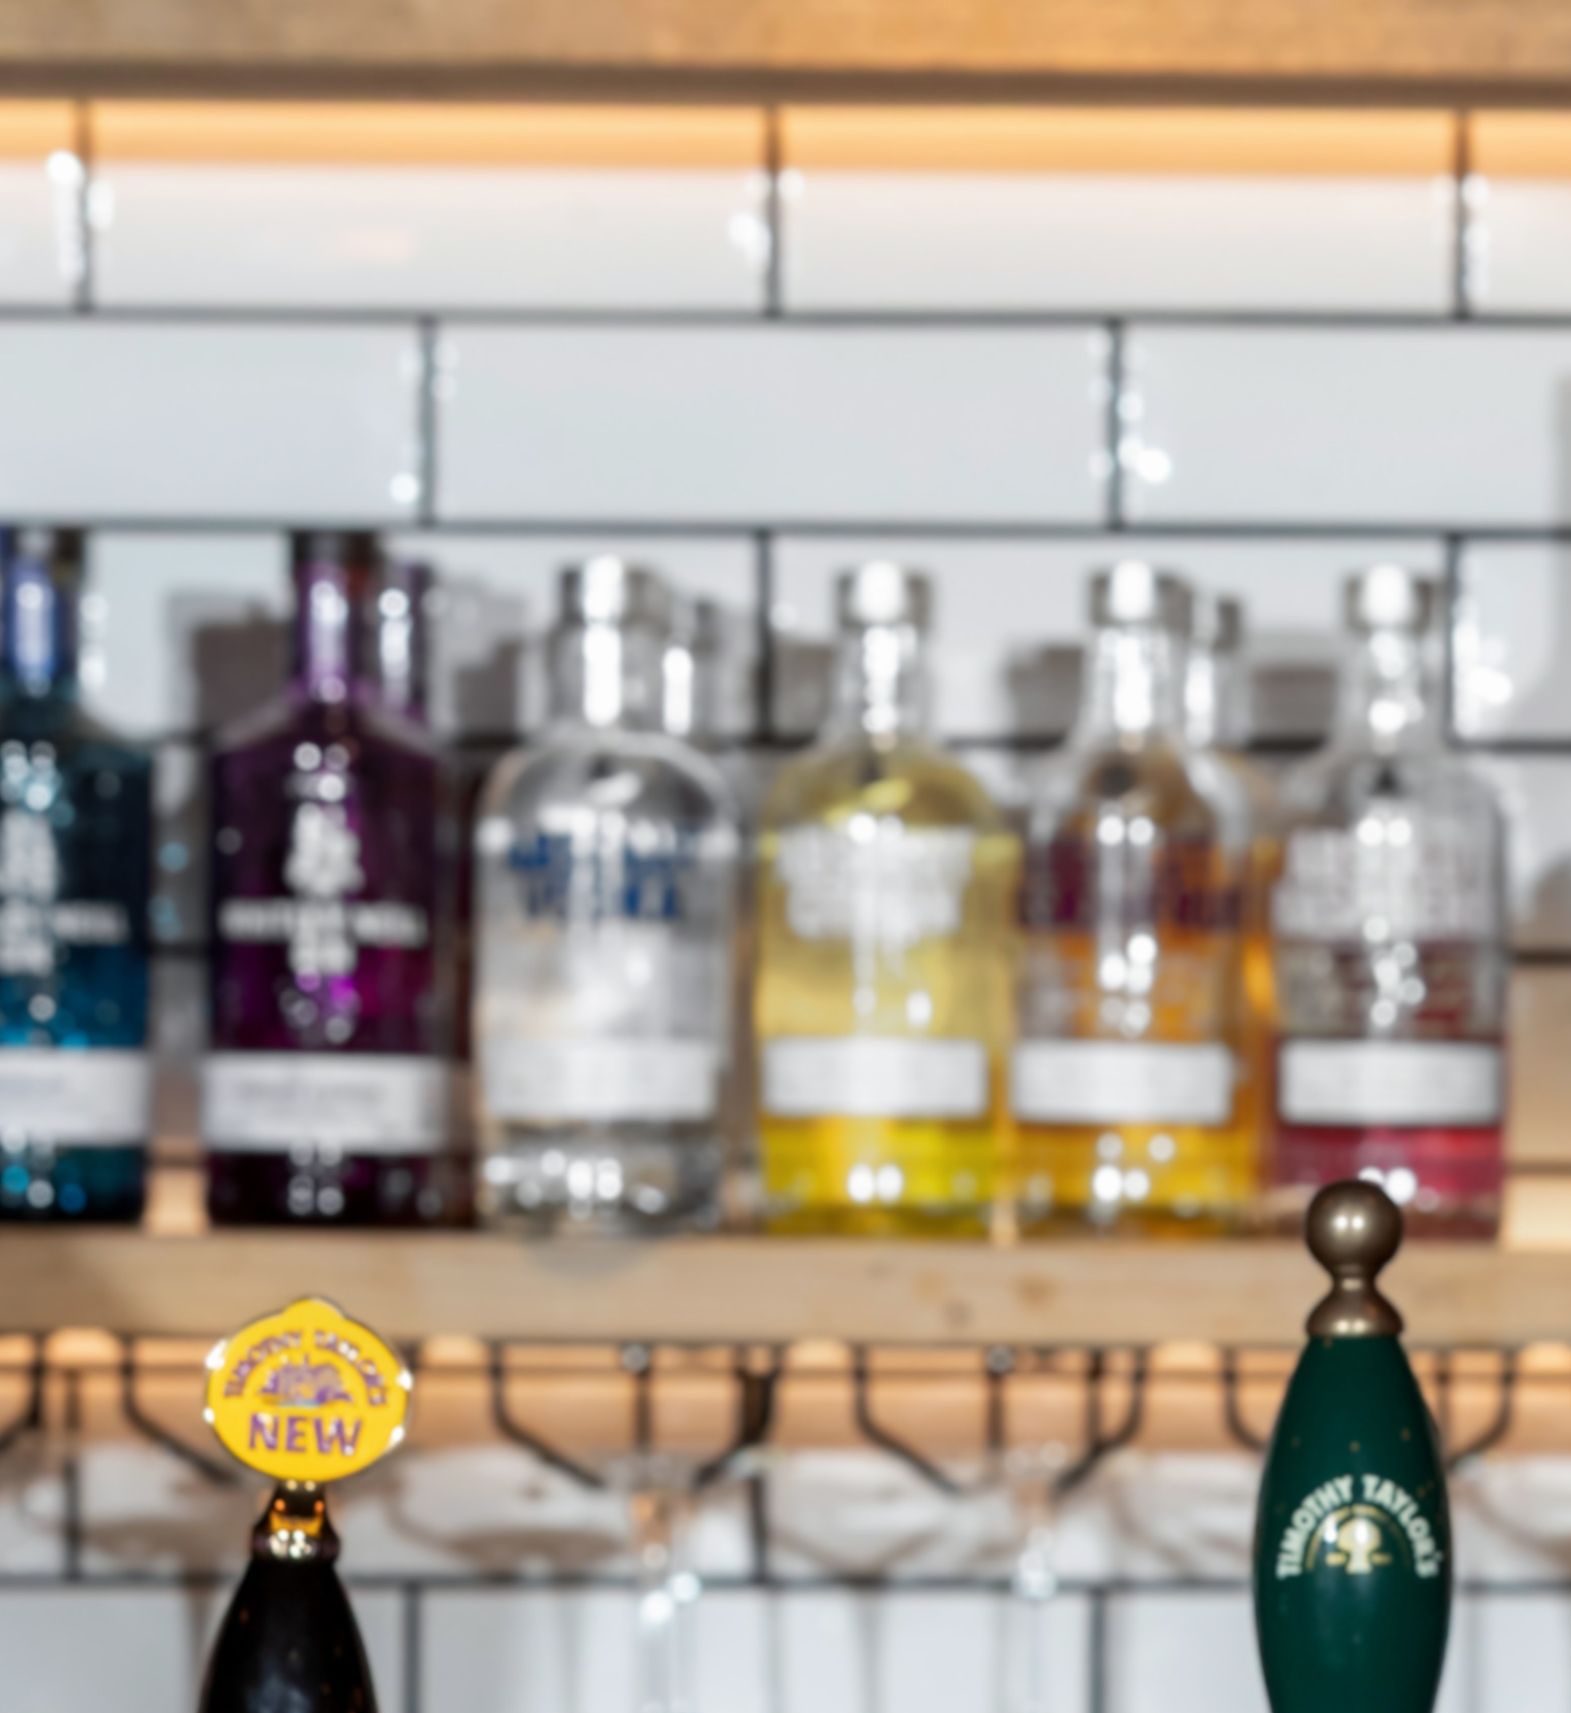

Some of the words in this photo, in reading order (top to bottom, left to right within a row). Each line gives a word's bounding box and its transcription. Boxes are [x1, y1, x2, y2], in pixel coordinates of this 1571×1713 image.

[248, 1413, 362, 1456] NEW
[1276, 1474, 1353, 1580] TIMOTHY
[1362, 1474, 1444, 1578] TAYLOR'S
